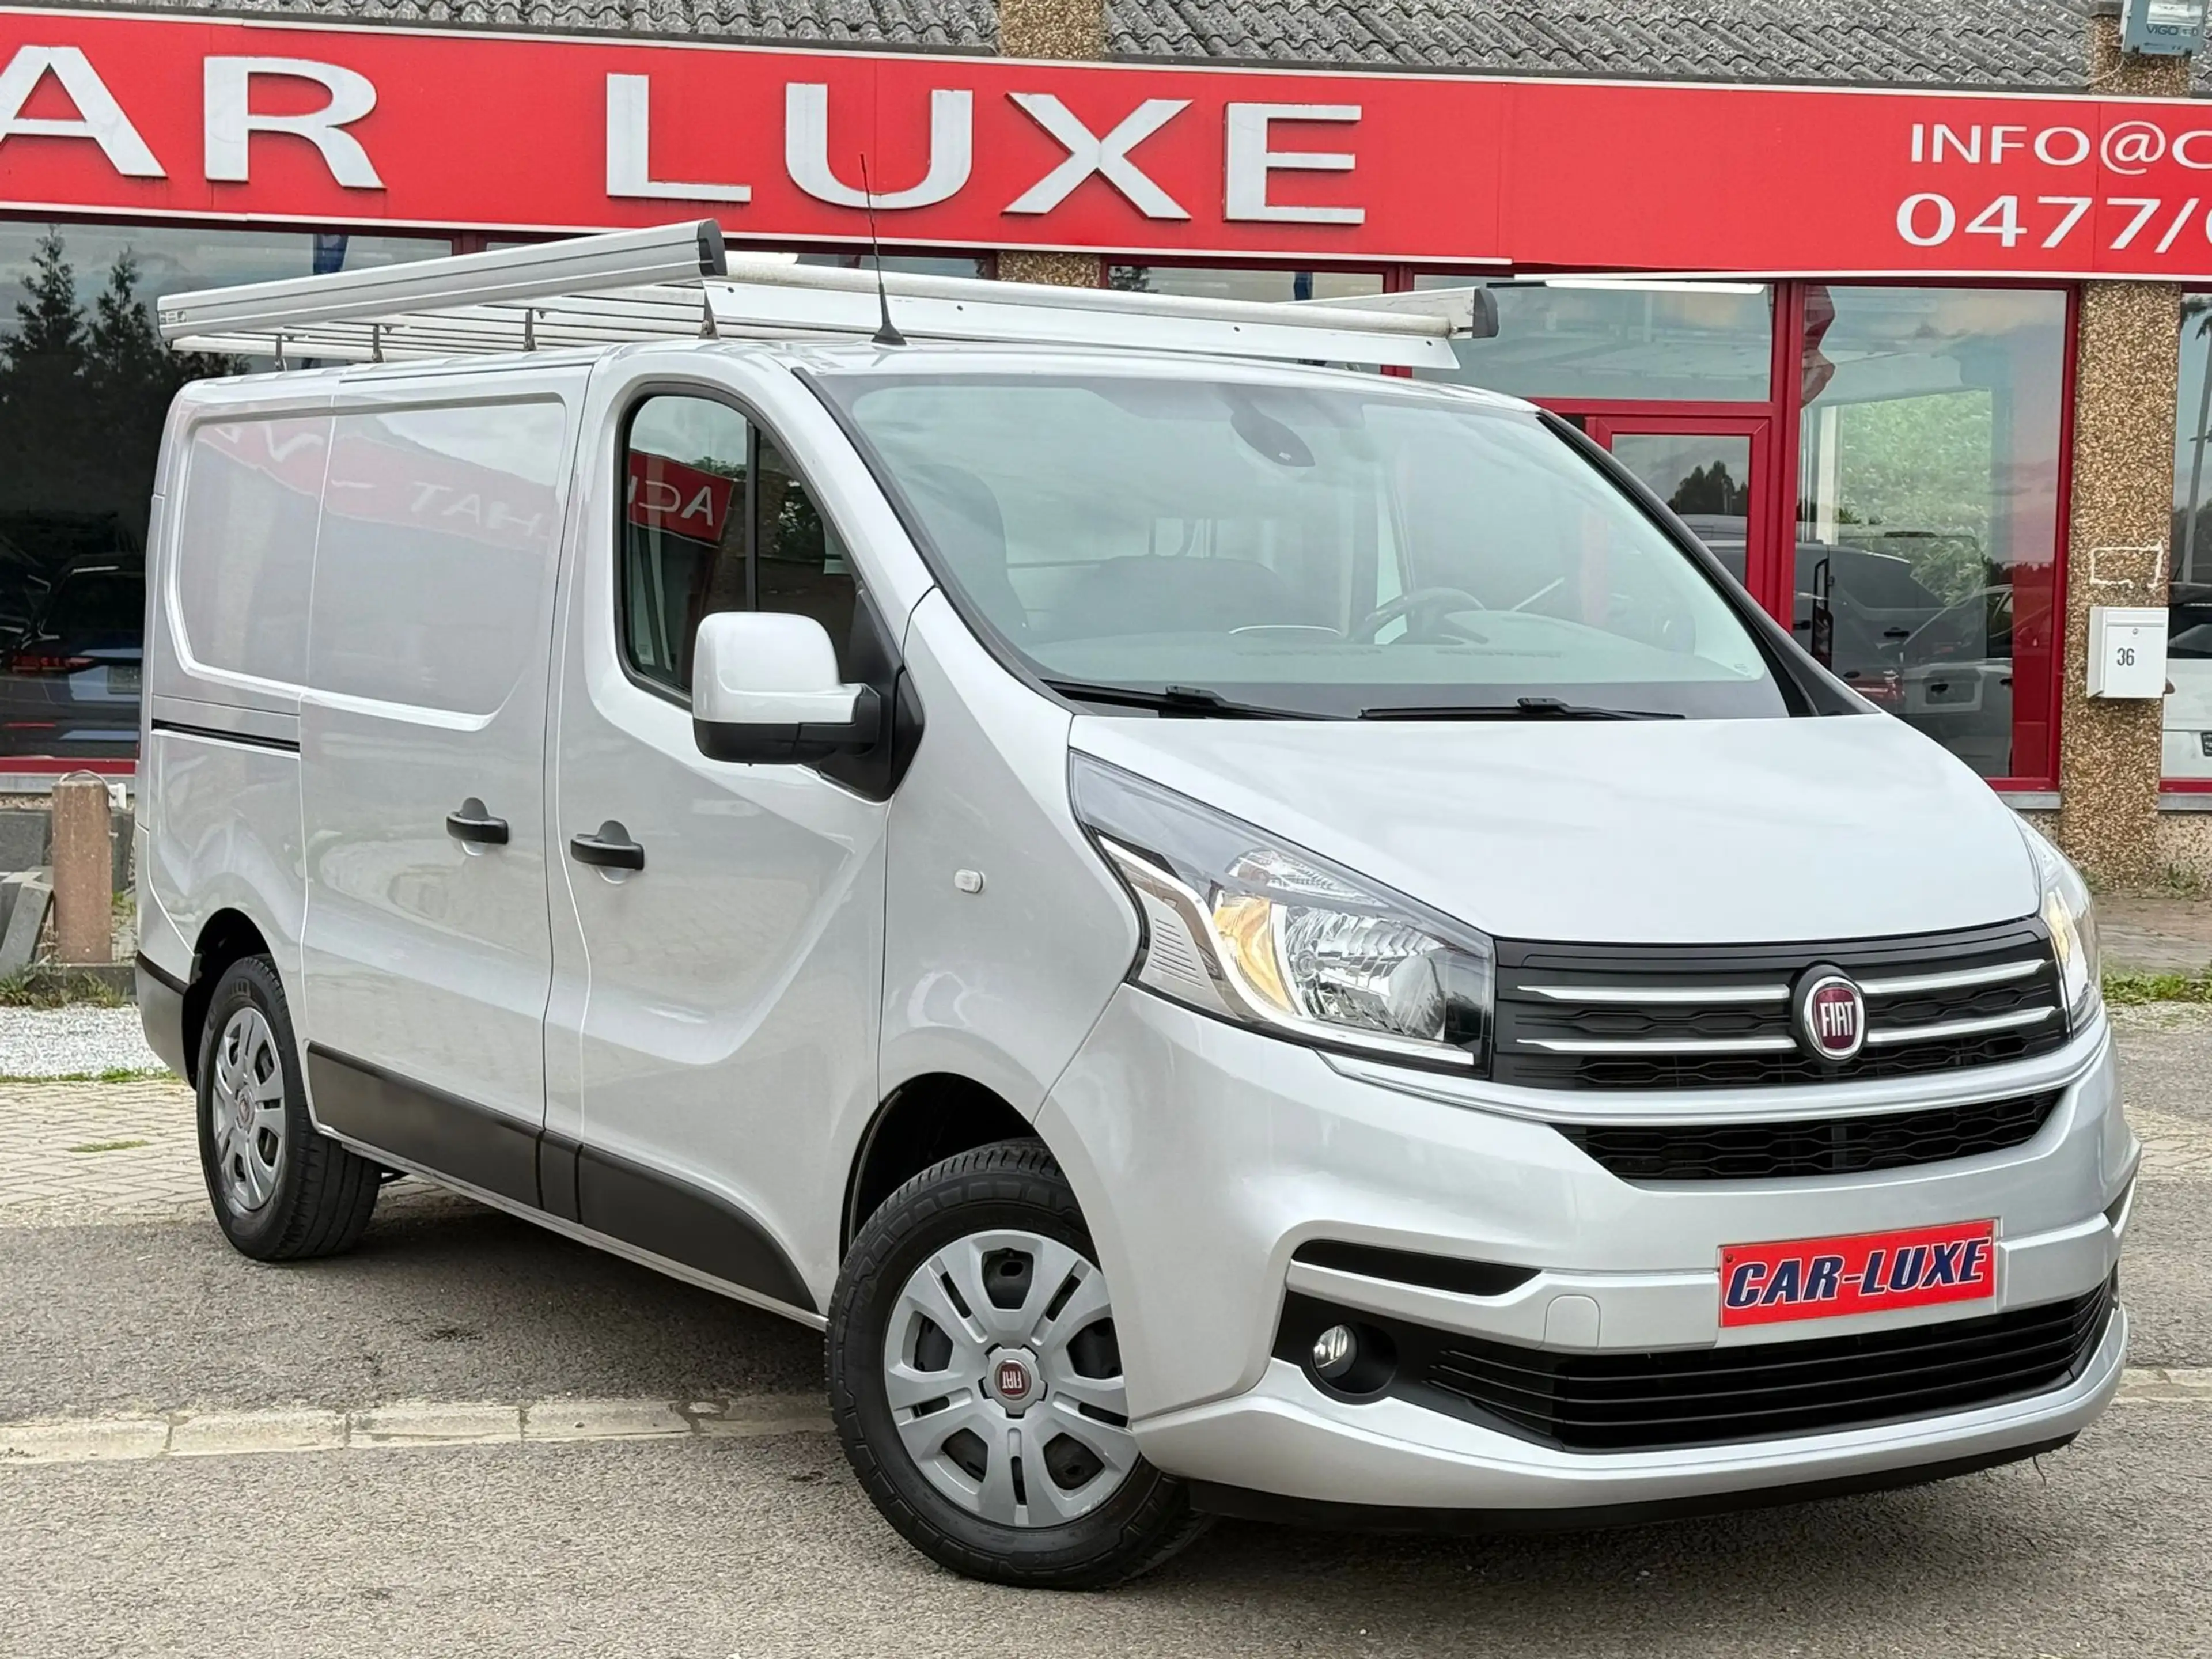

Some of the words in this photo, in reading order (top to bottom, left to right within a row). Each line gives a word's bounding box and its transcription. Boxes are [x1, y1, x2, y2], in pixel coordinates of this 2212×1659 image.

[2146, 25, 2179, 36] VIGO
[605, 73, 1366, 224] LUXE
[1896, 192, 2212, 254] 0477/
[2116, 647, 2135, 666] 36
[1820, 1001, 1854, 1037] FIAT
[1725, 1236, 1990, 1309] CAR-LUXE
[1002, 1370, 1023, 1389] FIAT
